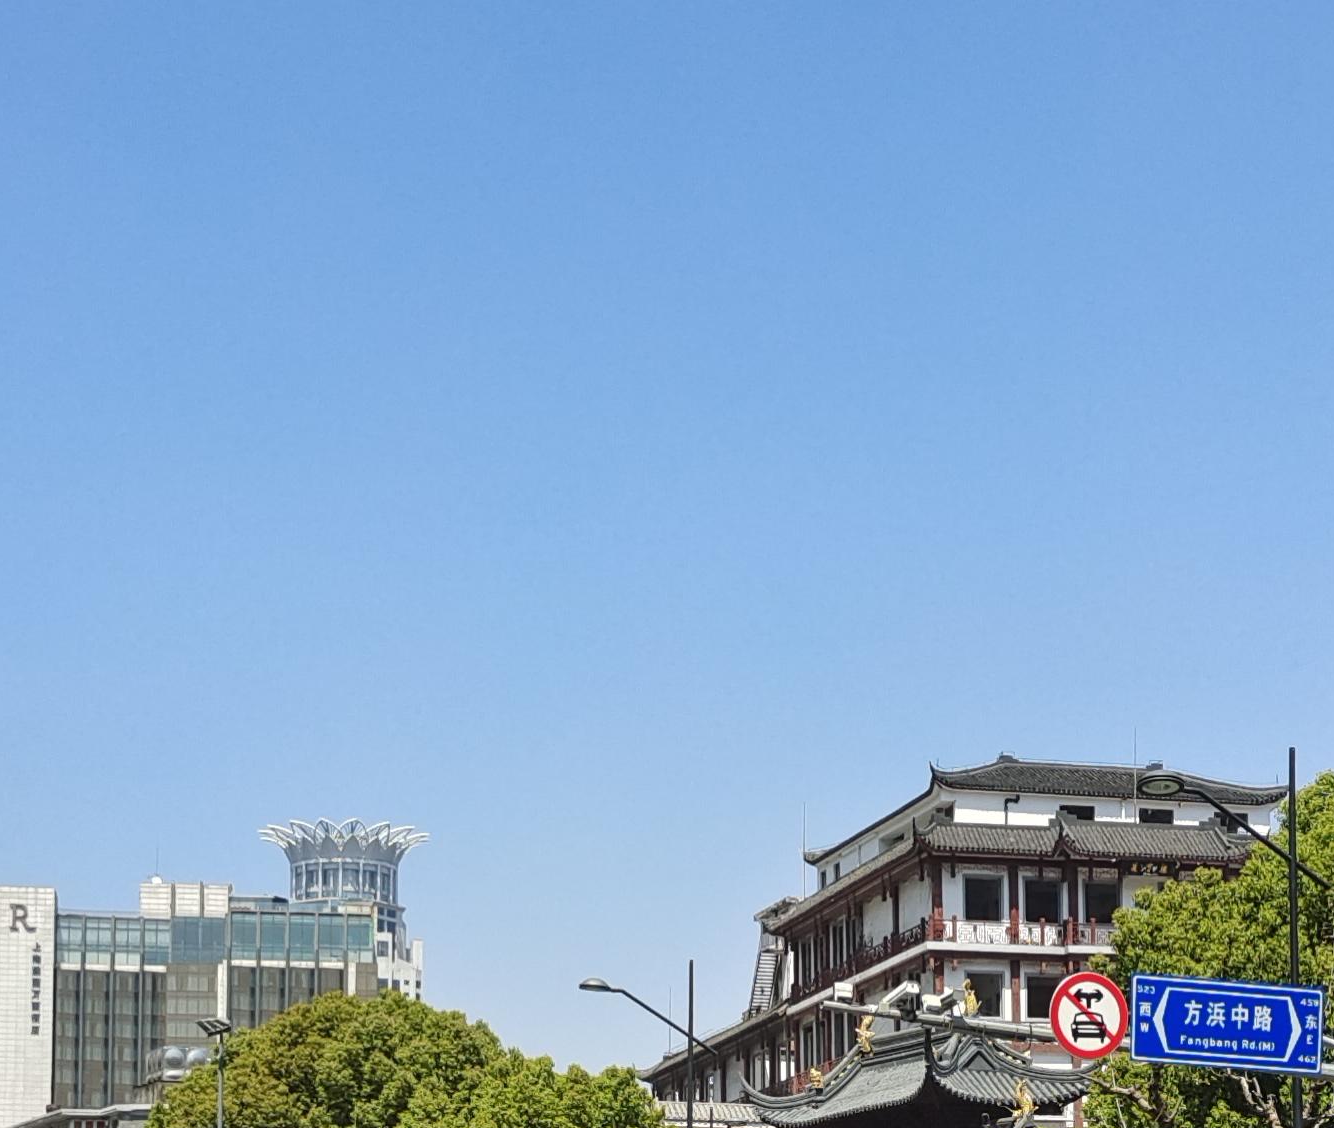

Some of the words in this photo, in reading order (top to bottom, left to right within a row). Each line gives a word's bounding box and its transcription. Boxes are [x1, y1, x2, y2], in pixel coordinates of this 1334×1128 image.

[9, 903, 37, 933] R
[1139, 1002, 1152, 1018] 西
[1184, 1000, 1273, 1033] 方浜中路
[1140, 1022, 1150, 1033] W
[1304, 1014, 1318, 1031] 东
[1180, 1034, 1238, 1051] Fangbang
[1306, 1034, 1314, 1045] E
